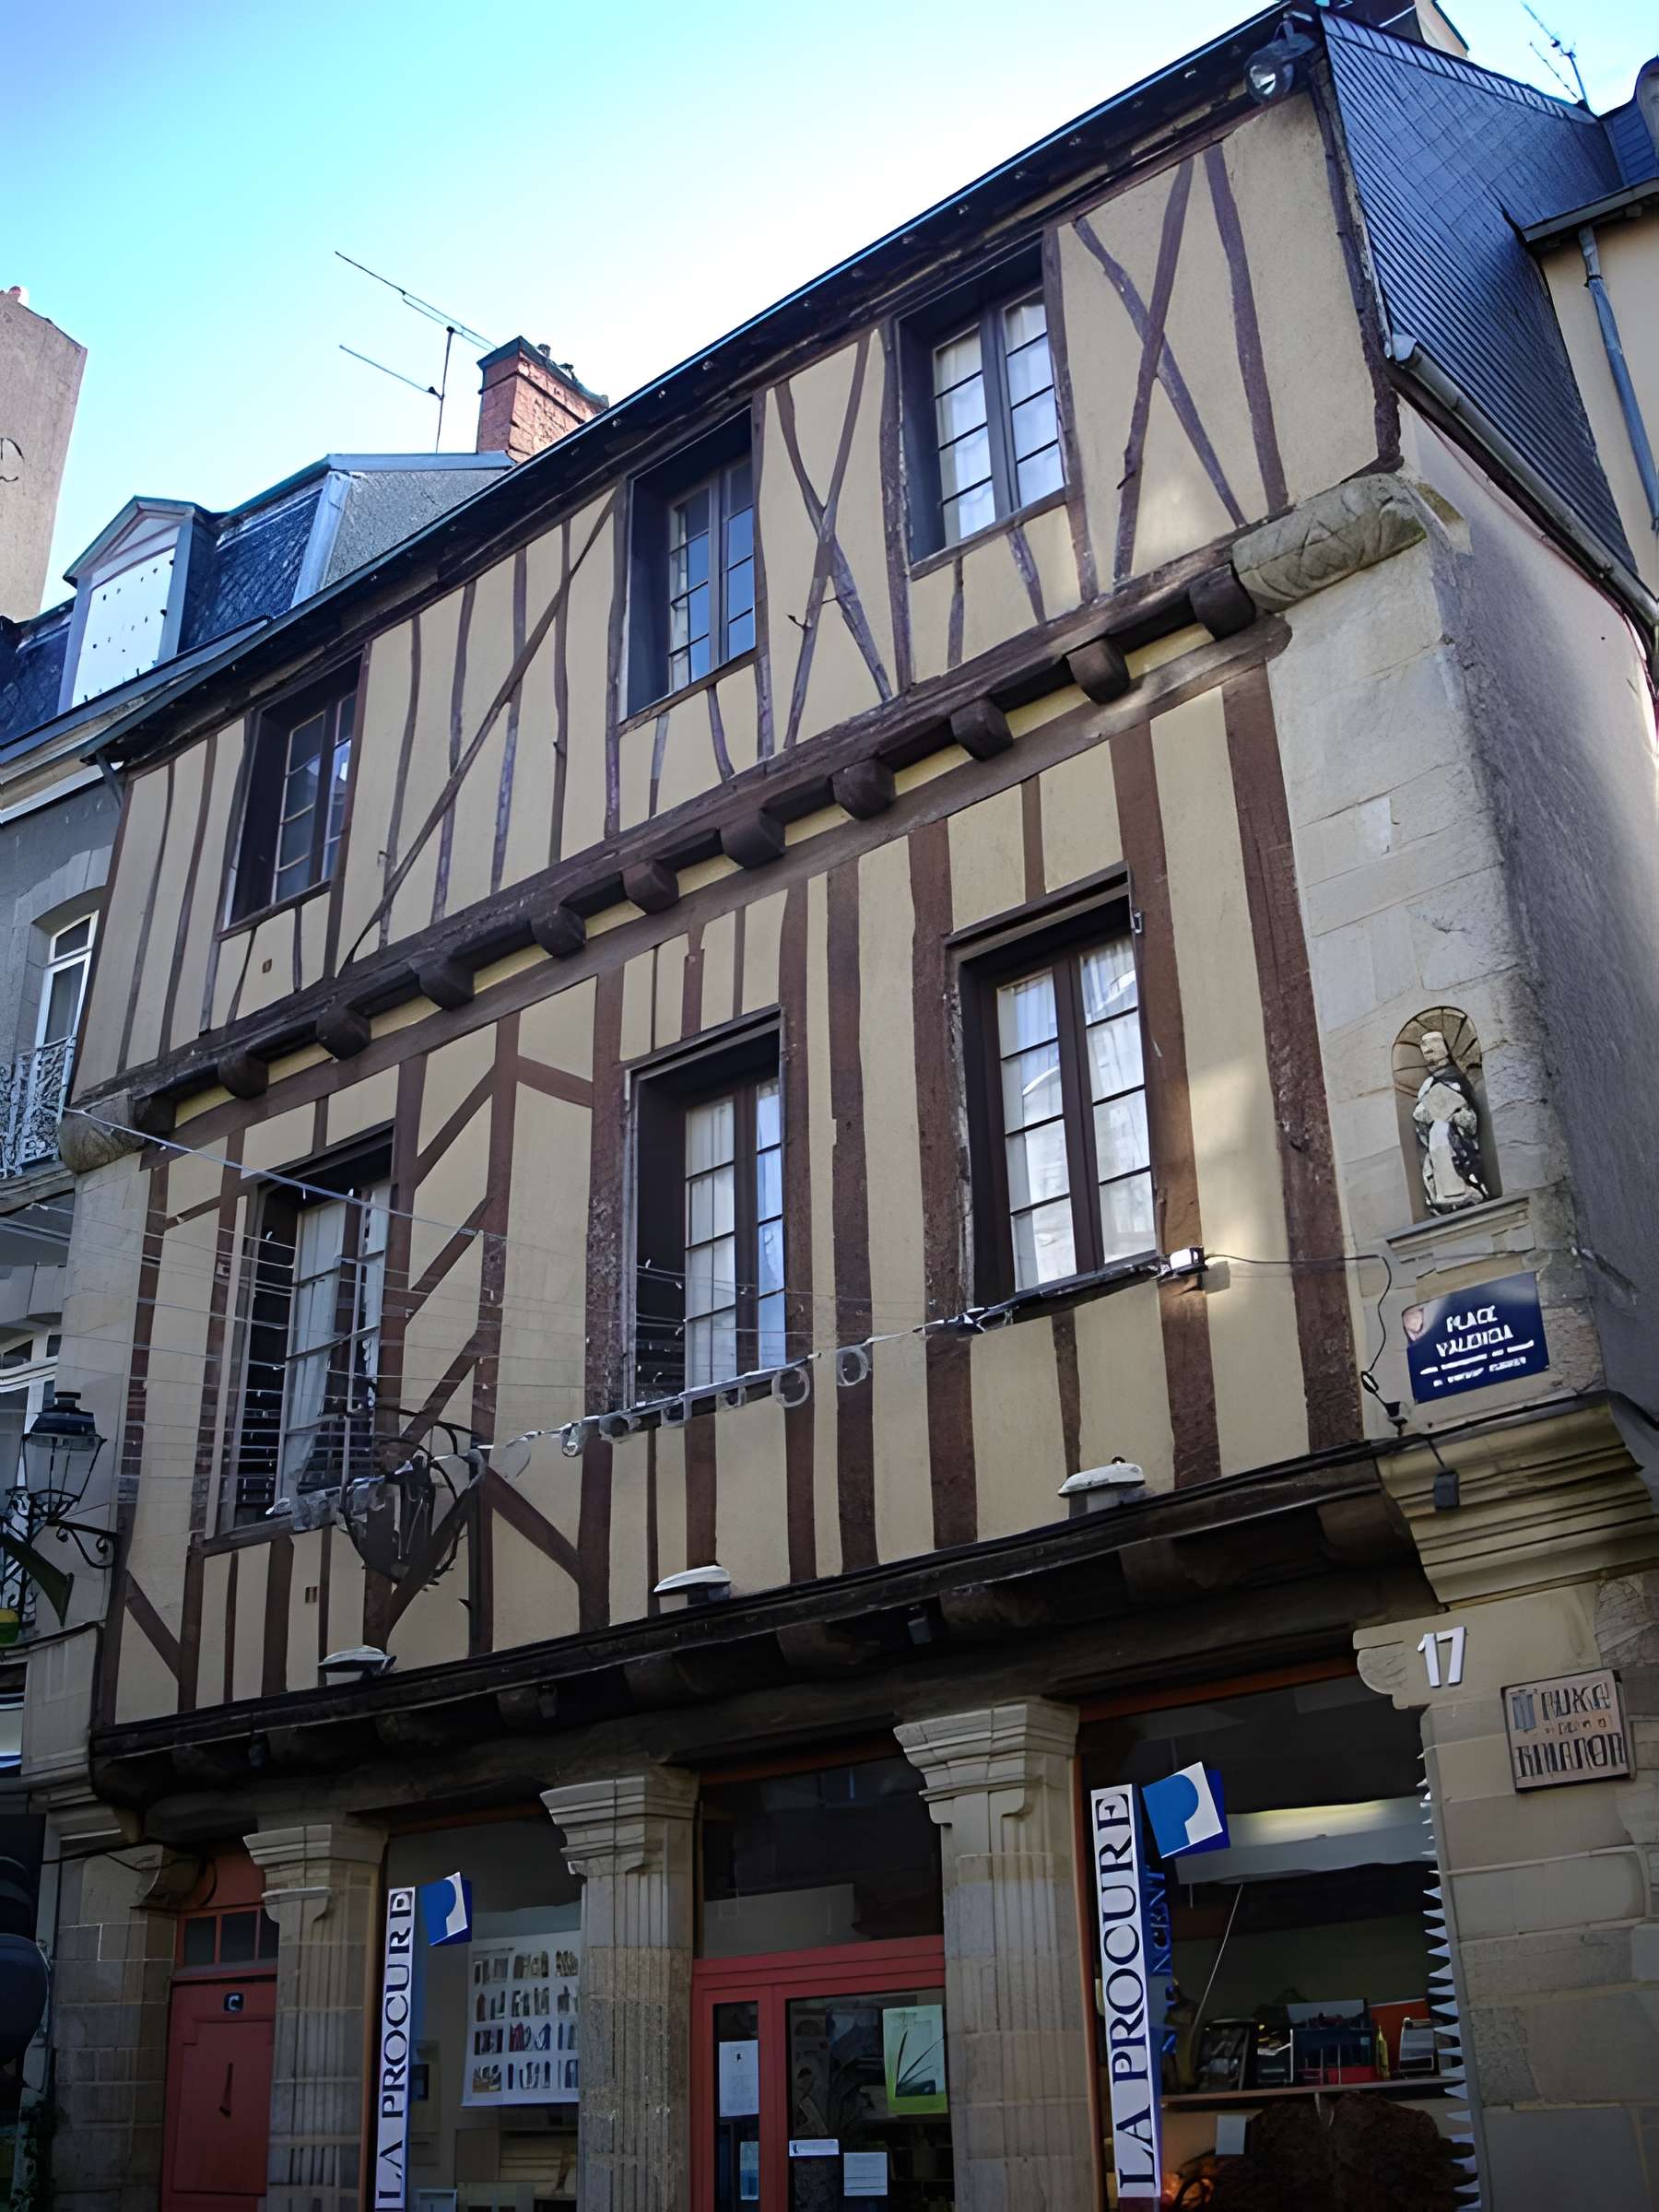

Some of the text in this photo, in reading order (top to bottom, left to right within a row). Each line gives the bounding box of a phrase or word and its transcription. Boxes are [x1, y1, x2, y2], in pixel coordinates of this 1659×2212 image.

[1446, 1304, 1499, 1333] PLACE
[1417, 1626, 1466, 1688] 17
[1095, 1793, 1158, 2192] LA PROCURE
[377, 2140, 405, 2200] LA
